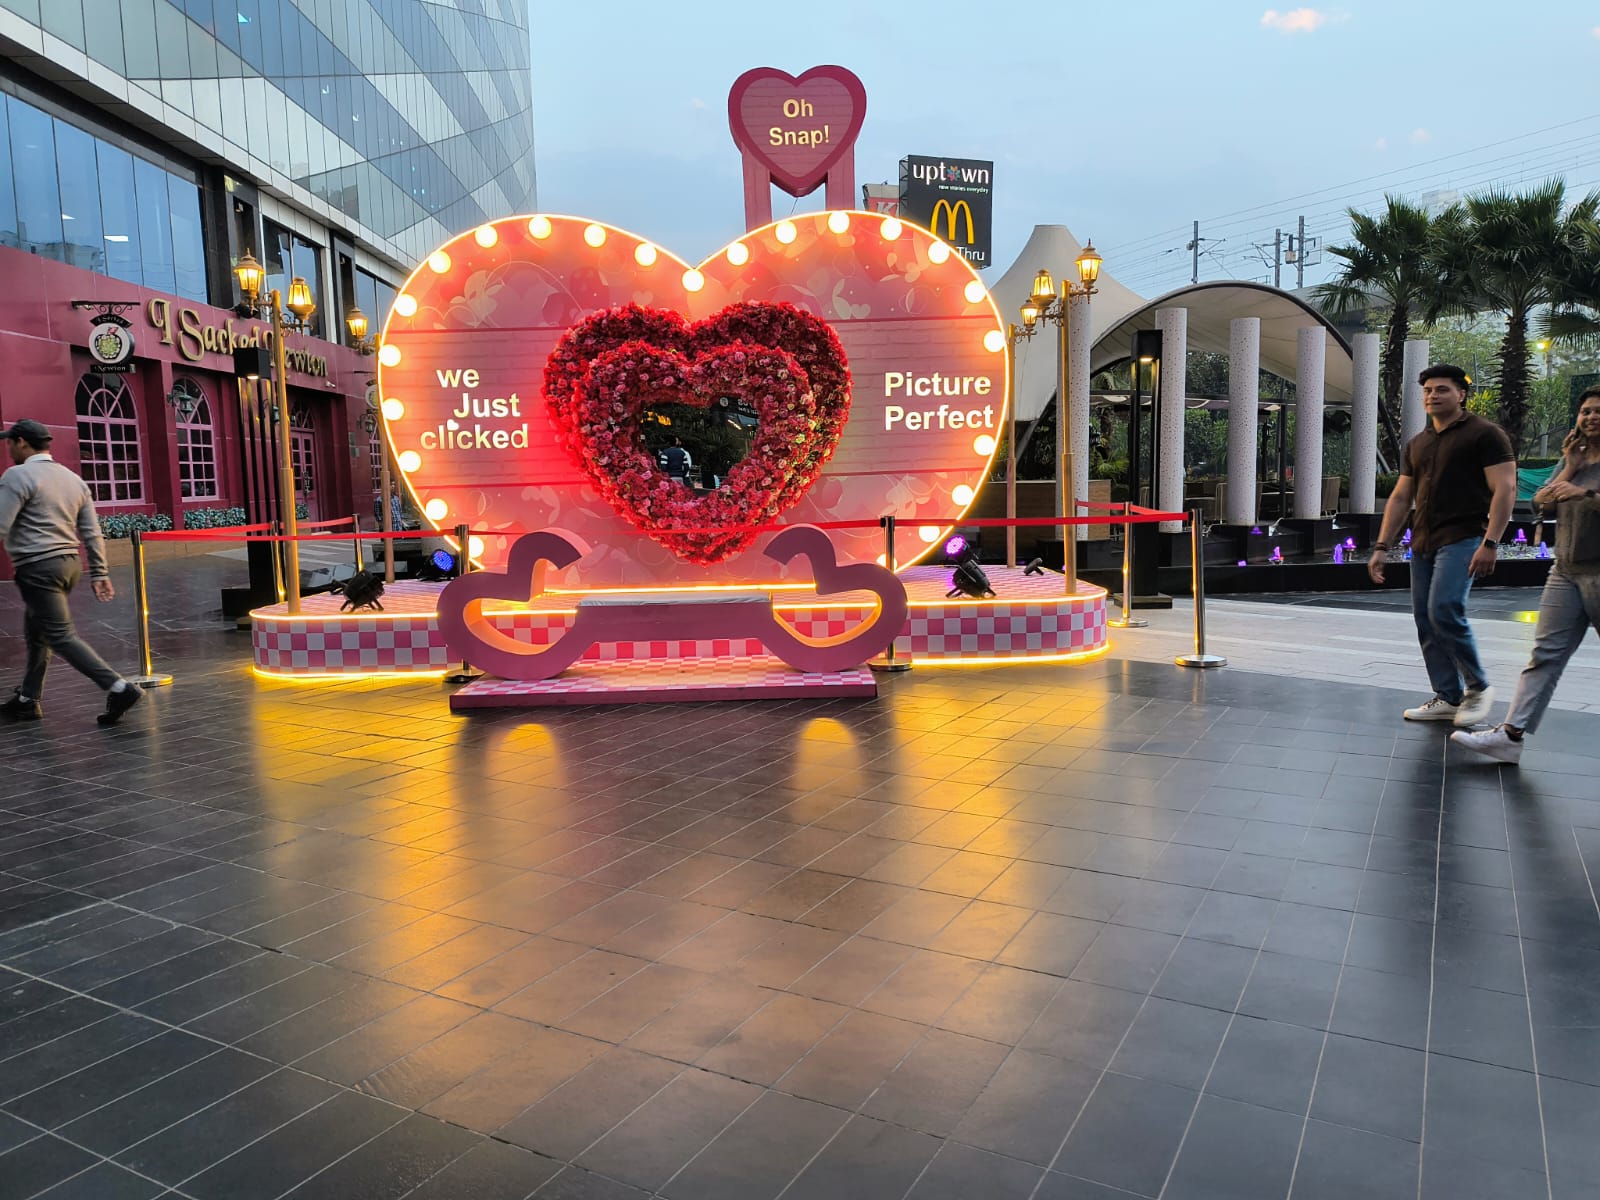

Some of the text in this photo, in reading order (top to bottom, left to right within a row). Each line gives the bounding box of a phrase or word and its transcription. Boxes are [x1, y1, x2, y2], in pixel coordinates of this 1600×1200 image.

[783, 98, 814, 118] Oh
[769, 125, 830, 149] Snap!
[436, 368, 480, 388] we
[884, 372, 992, 397] Picture
[453, 392, 521, 418] Just
[885, 404, 994, 431] Perfect
[420, 419, 529, 449] clicked
